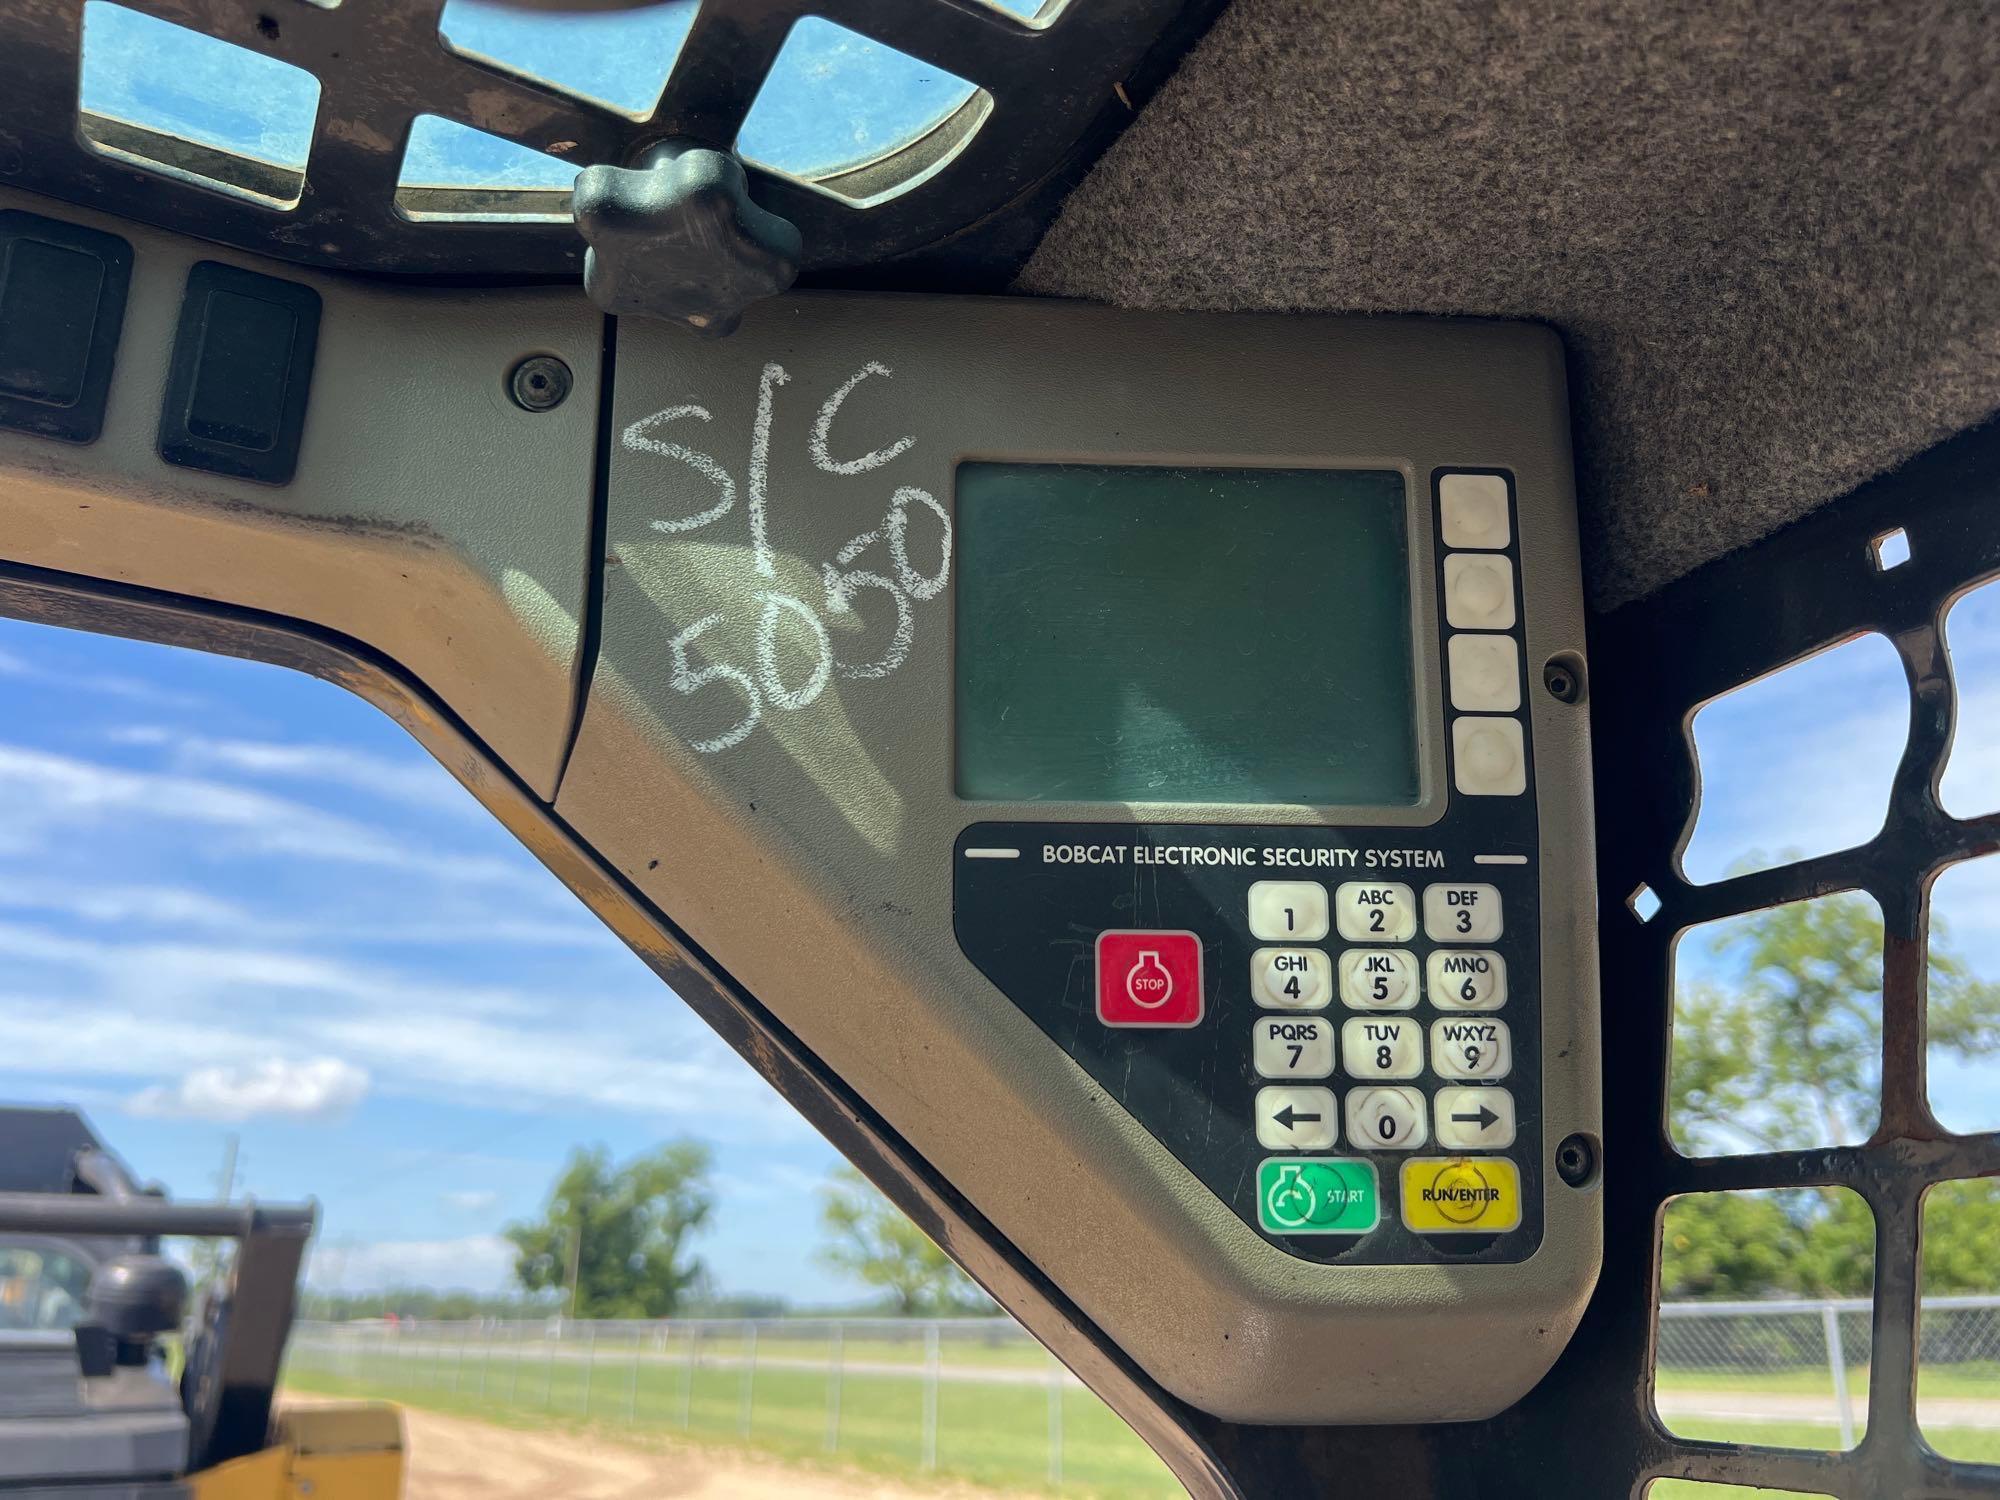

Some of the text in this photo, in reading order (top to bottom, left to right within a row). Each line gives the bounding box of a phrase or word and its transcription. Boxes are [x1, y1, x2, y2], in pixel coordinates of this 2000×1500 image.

[668, 486, 952, 754] 5050
[1043, 845, 1445, 868] BOBCAT ELECTRONIC SECURITY SYSTEM
[1357, 889, 1394, 905] ABC
[1447, 890, 1478, 906] DEF
[1283, 908, 1295, 931] 1
[1370, 910, 1385, 932] 2
[1456, 910, 1472, 933] 3
[1274, 956, 1308, 972] GHI
[1364, 957, 1395, 973] JKL
[1444, 957, 1489, 974] MNO
[1135, 977, 1165, 991] STOP
[1283, 977, 1300, 999] 4
[1372, 978, 1388, 1000] 5
[1460, 978, 1477, 1001] 6
[1269, 1024, 1317, 1042] PQRS
[1363, 1025, 1400, 1041] TUV
[1443, 1025, 1496, 1042] WXYZ
[1287, 1045, 1302, 1069] 7
[1376, 1045, 1392, 1069] 8
[1464, 1046, 1479, 1070] 9
[1379, 1114, 1396, 1139] 0
[1327, 1189, 1364, 1204] START
[1422, 1188, 1499, 1202] RUN/ENTER
